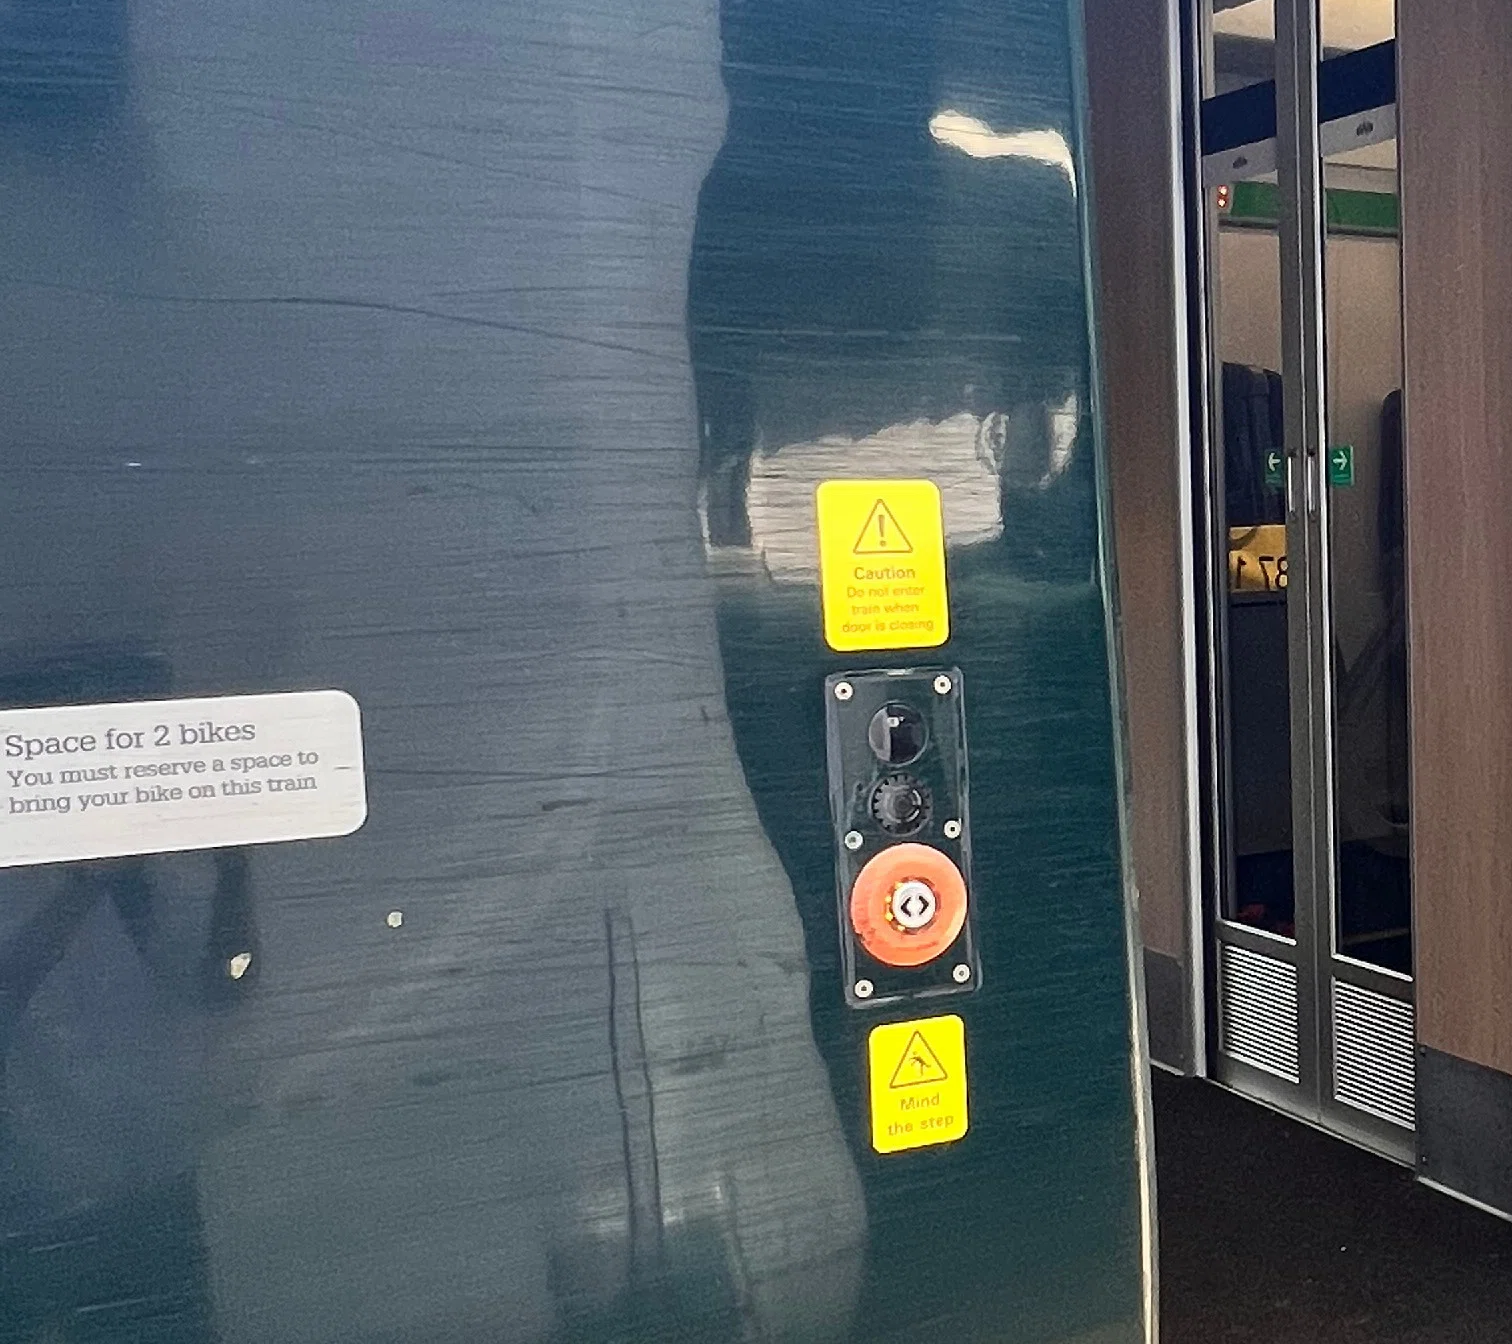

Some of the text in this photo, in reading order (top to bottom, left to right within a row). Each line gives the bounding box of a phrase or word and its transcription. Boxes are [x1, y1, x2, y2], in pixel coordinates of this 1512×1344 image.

[854, 566, 916, 580] Caution
[846, 584, 925, 599] Do not enter
[851, 602, 920, 616] train when
[842, 619, 935, 633] door is closing
[5, 720, 257, 760] Space for 2 bikes
[7, 750, 320, 789] You must reserve a space to
[8, 774, 319, 815] bring your bike on this train
[899, 1092, 941, 1111] Mind
[888, 1114, 954, 1136] the step
